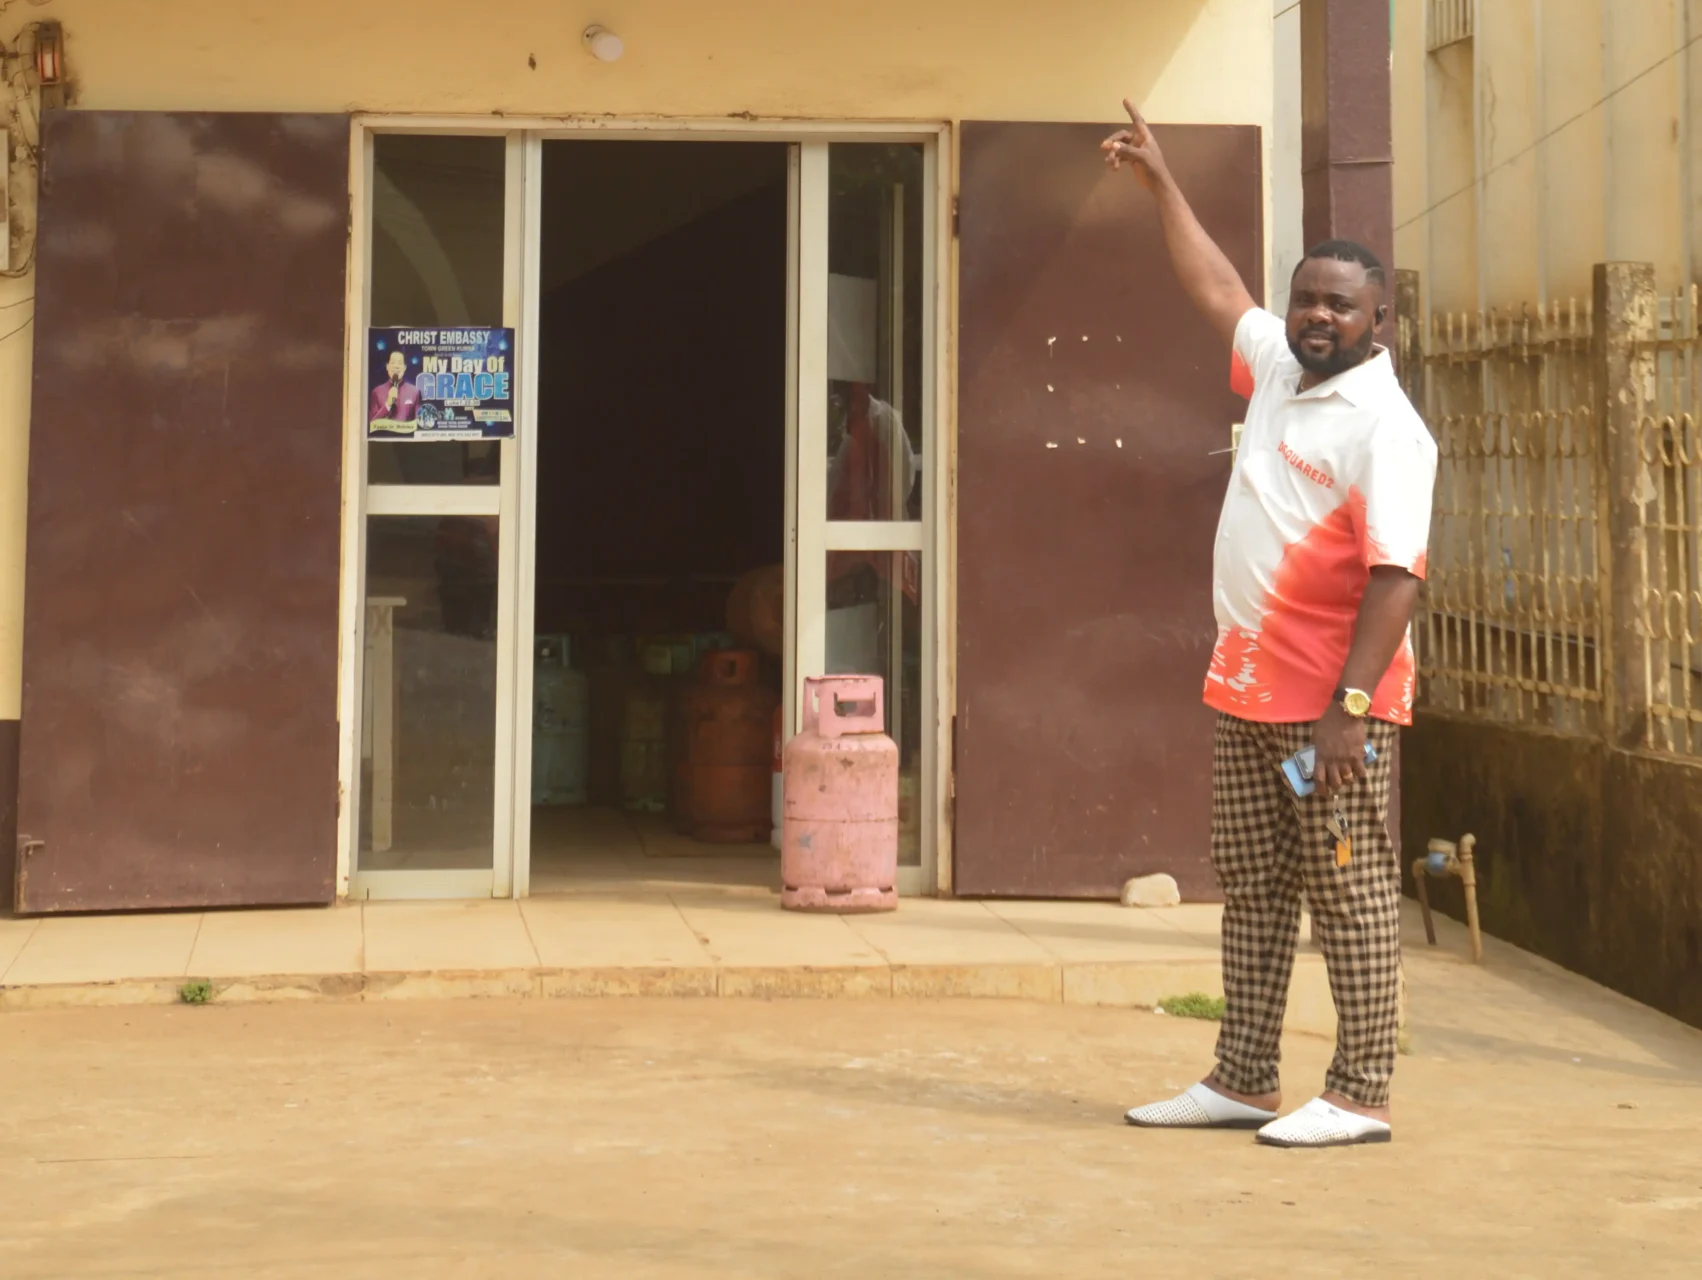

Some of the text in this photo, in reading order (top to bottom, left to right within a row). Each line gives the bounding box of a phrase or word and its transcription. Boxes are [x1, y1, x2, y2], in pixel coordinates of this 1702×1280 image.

[398, 331, 490, 345] CHRIST EMBASSY
[422, 355, 505, 374] My Day Of
[416, 372, 509, 401] GRACE
